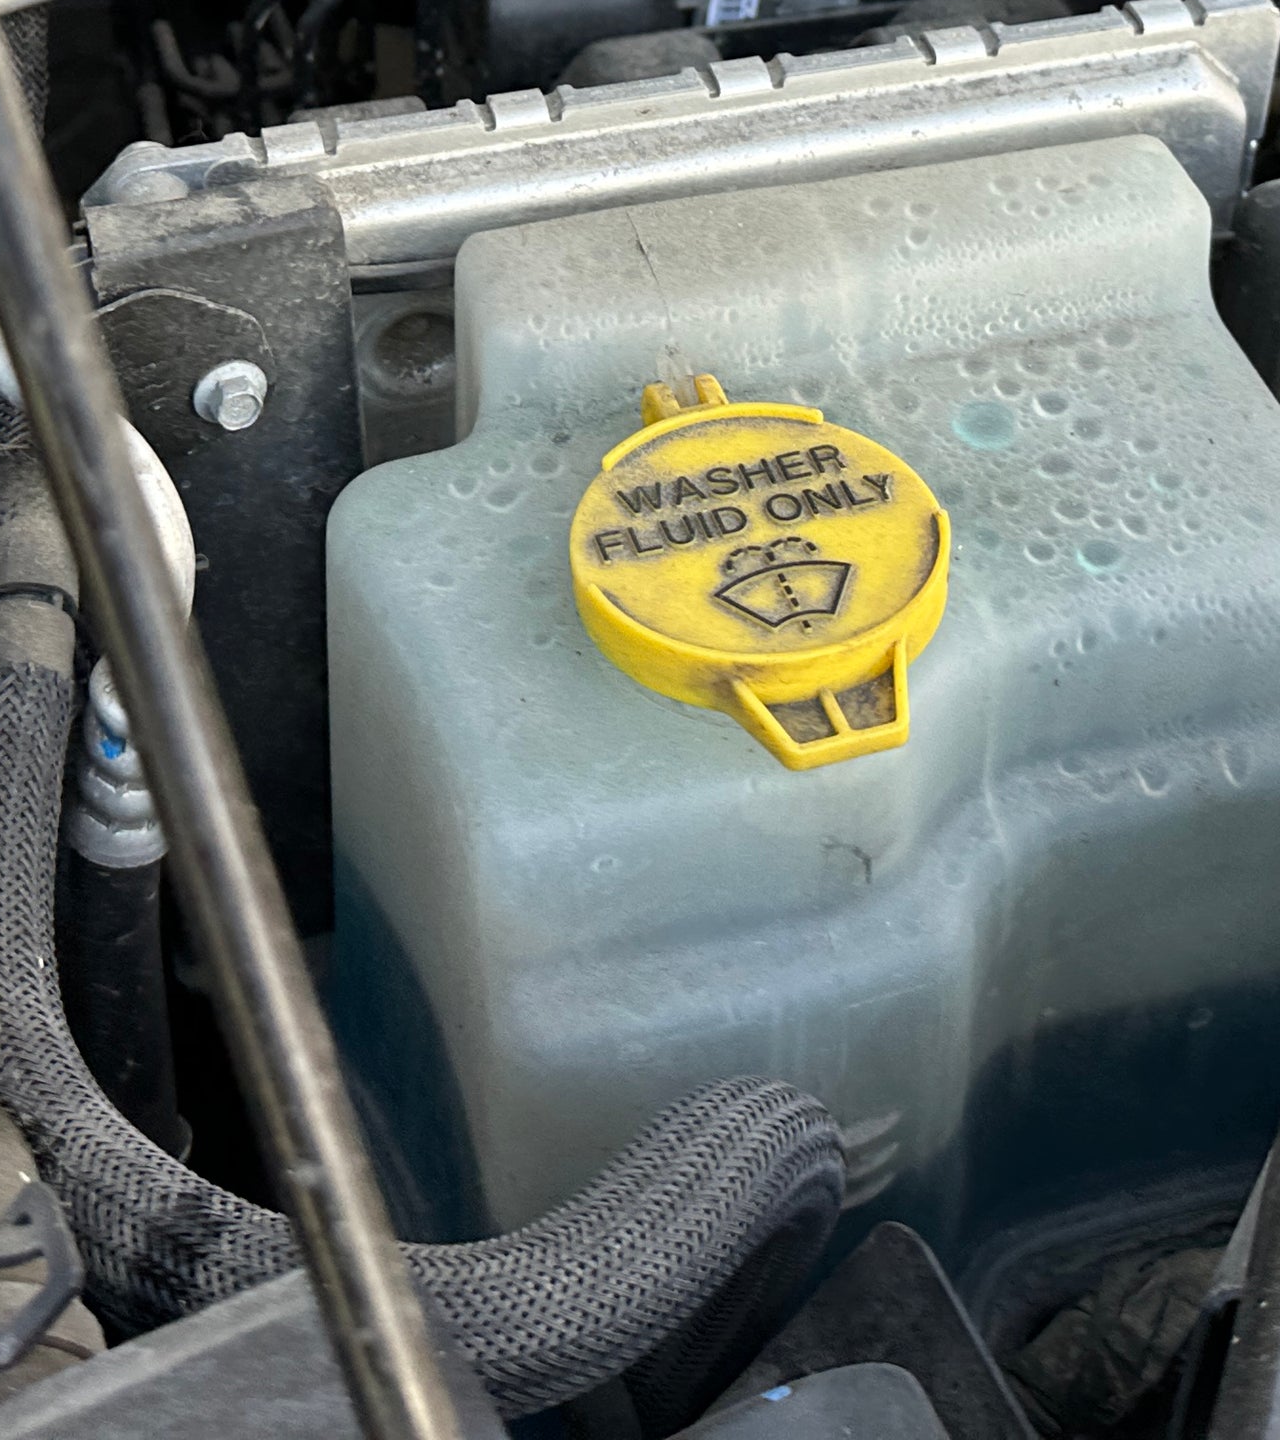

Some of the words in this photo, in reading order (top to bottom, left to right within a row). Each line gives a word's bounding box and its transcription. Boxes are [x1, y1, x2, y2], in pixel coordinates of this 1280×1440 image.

[593, 505, 748, 564] FLUID
[765, 472, 894, 523] ONLY
[615, 443, 849, 516] WASHER
